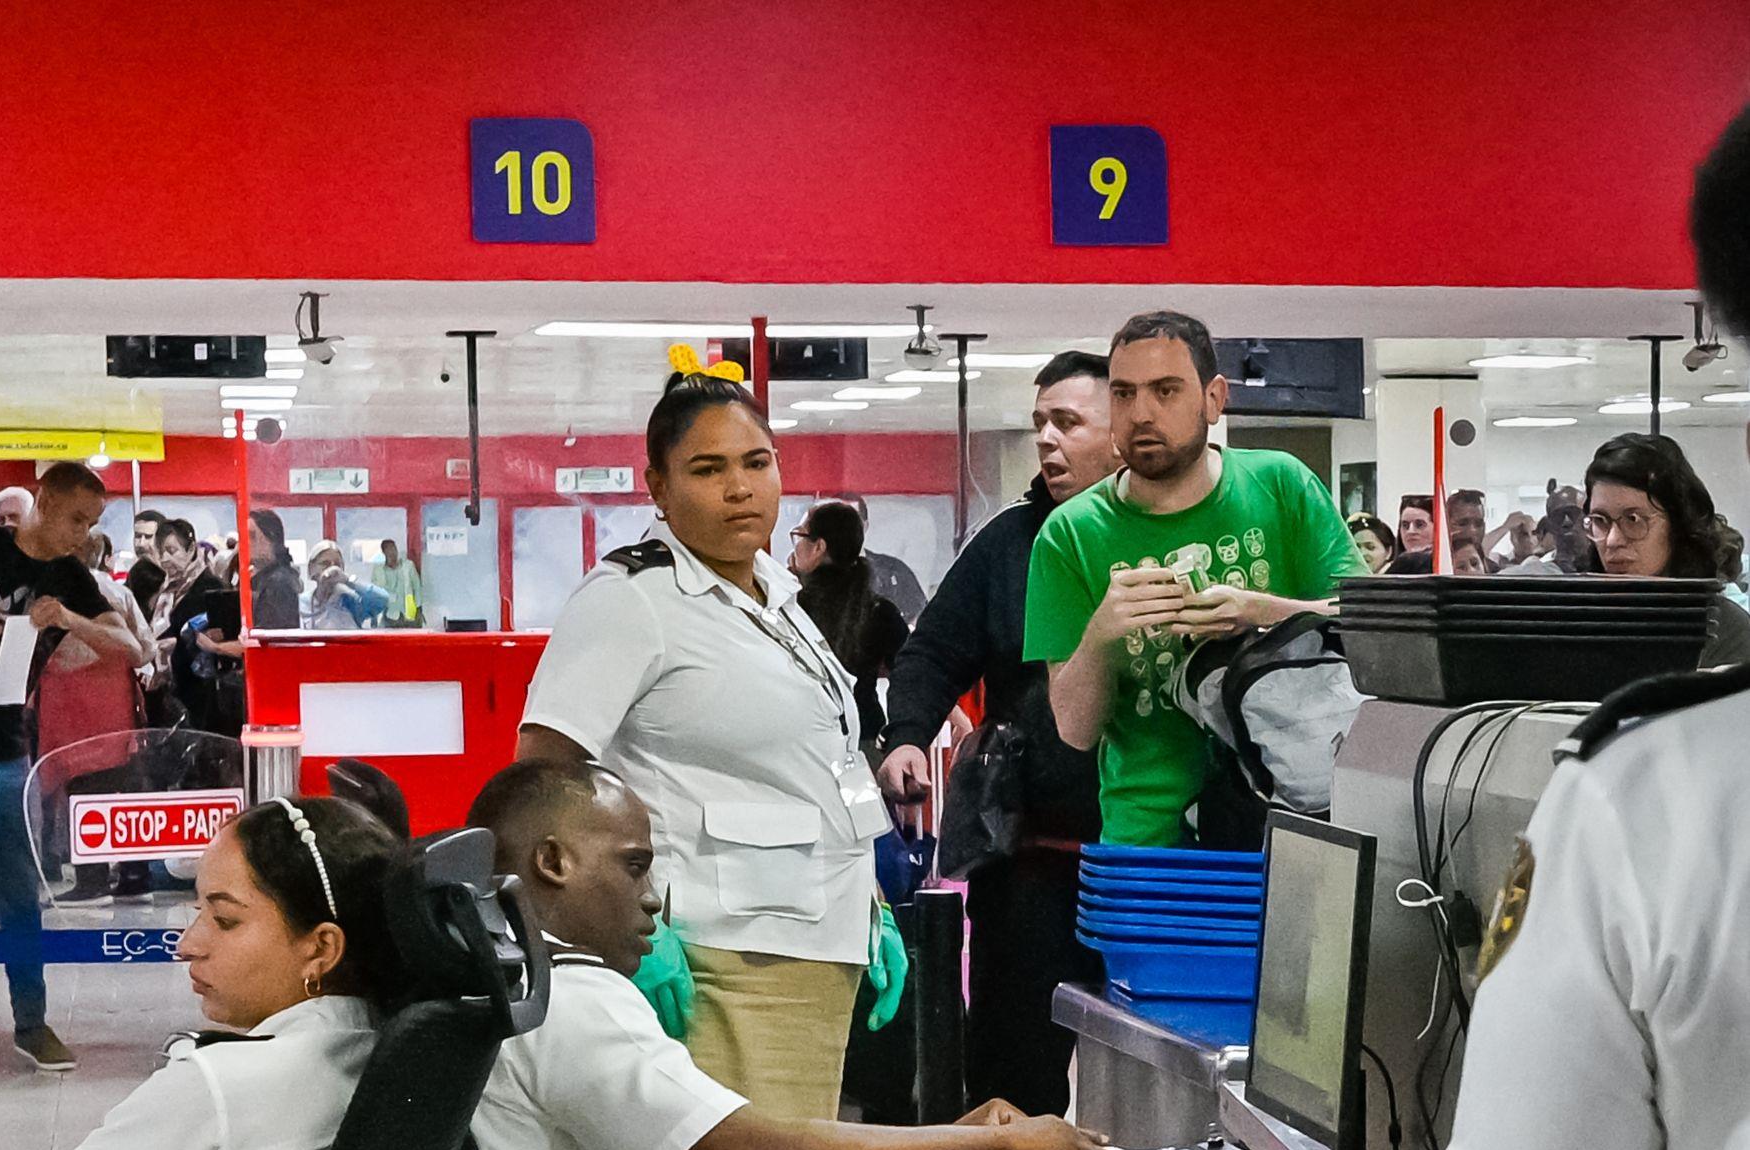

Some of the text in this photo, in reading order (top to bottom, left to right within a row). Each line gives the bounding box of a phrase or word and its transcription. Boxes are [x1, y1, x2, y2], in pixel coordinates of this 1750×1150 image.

[494, 150, 572, 215] 10
[1088, 157, 1128, 220] 9
[114, 810, 168, 844] STOP
